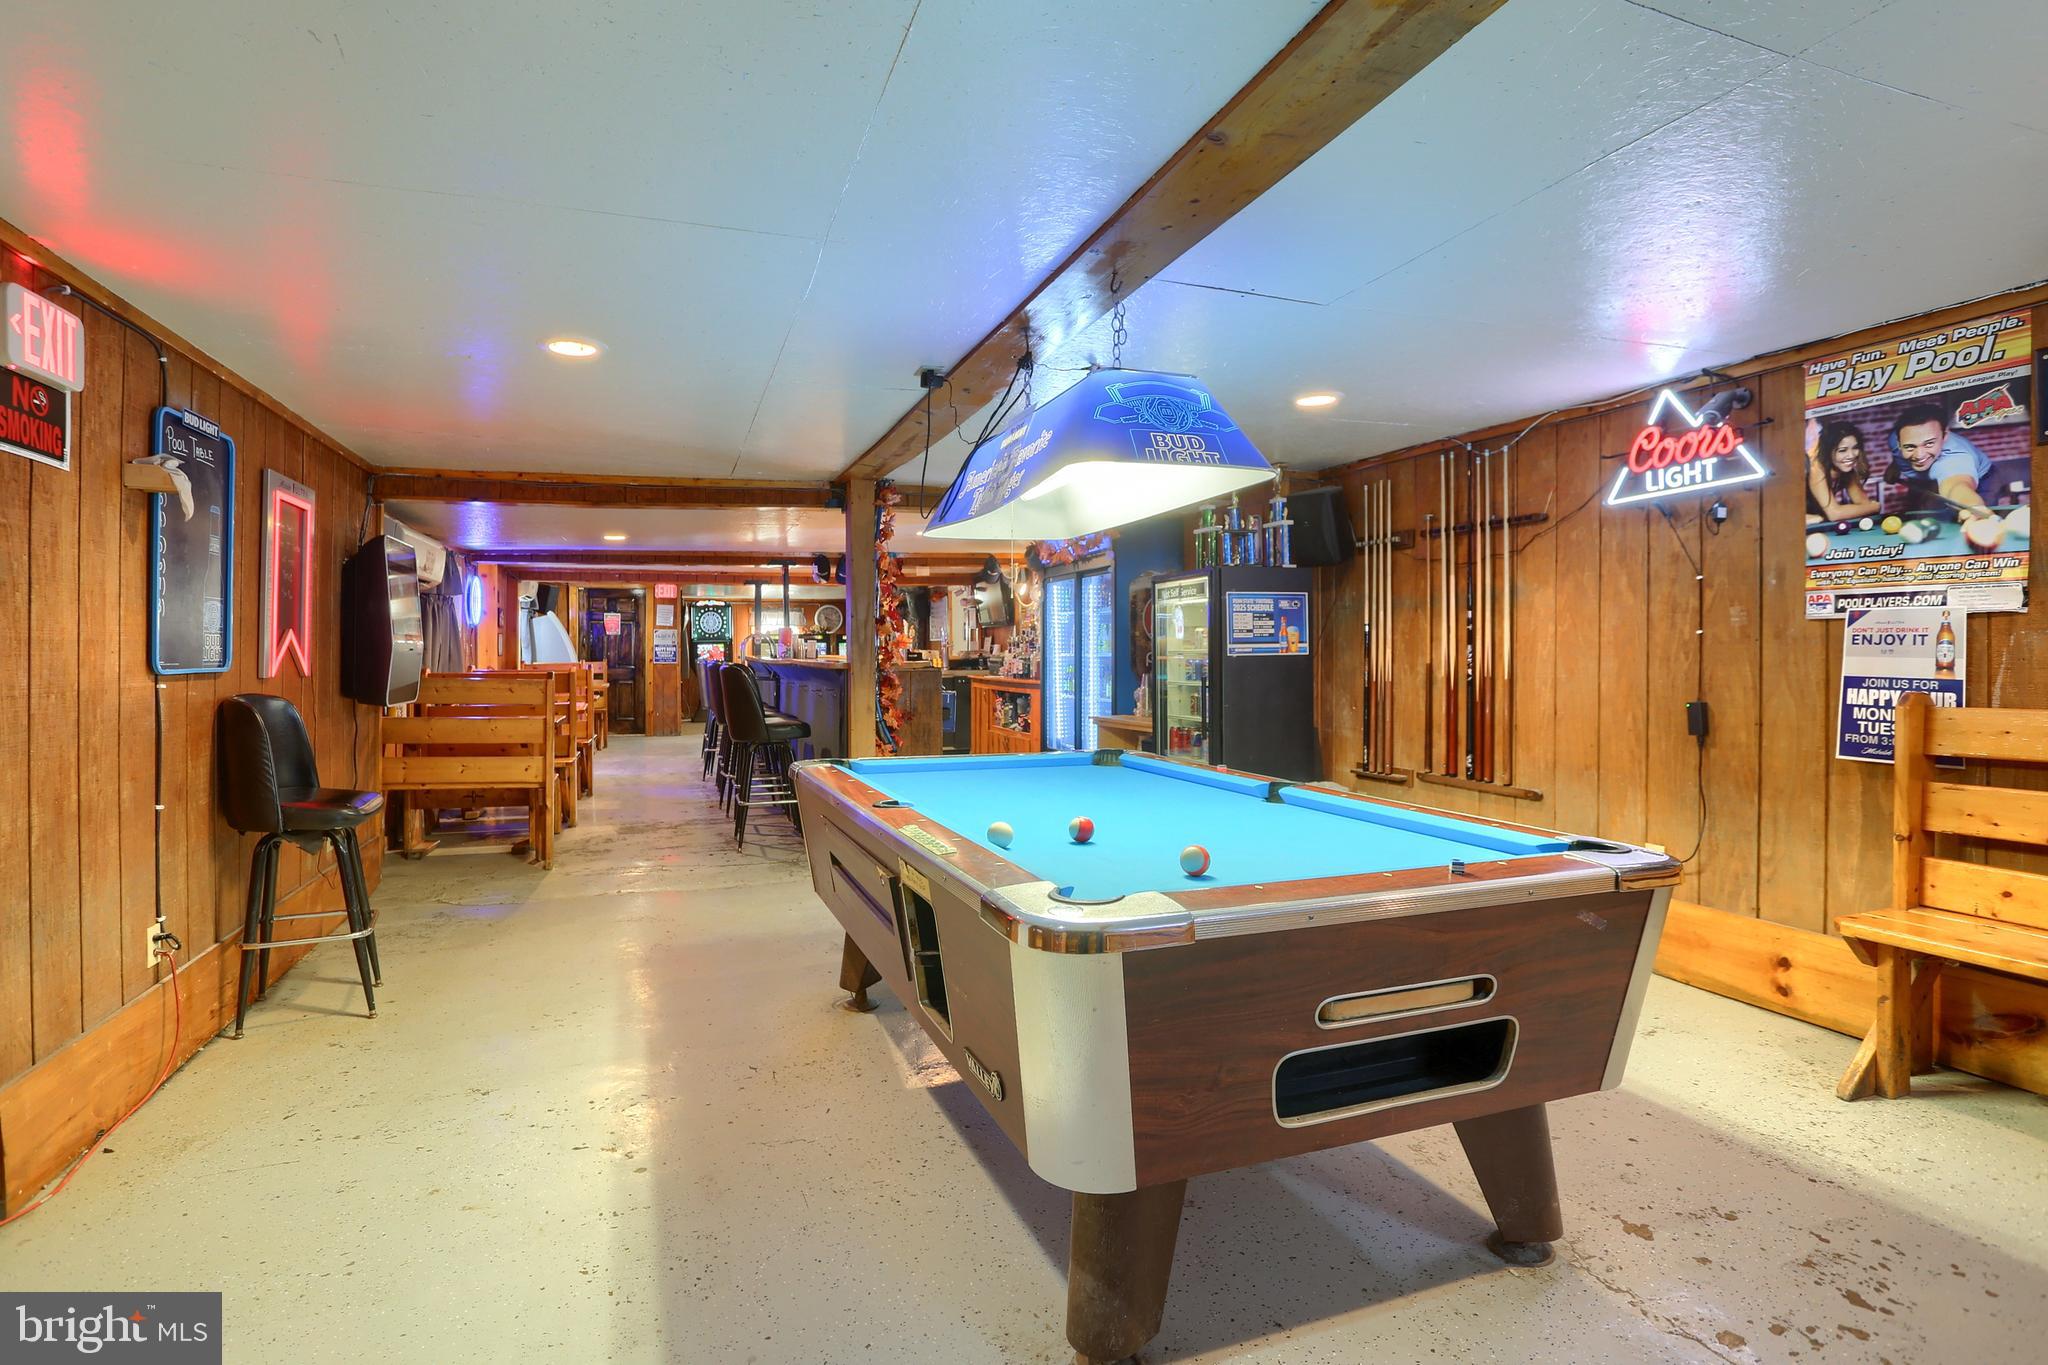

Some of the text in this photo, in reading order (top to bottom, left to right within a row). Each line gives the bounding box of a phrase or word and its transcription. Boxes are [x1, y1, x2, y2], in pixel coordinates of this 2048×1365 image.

[23, 291, 78, 383] EXIT
[1808, 316, 2024, 375] Have Fun. Meet People.
[1817, 334, 2006, 398] Play Pool.
[1923, 385, 1939, 393] APA
[1940, 380, 1966, 389] weekly
[1967, 374, 1996, 384] League
[0, 405, 63, 457] SMOKING
[184, 411, 219, 437] BUD LIGHT
[1150, 432, 1206, 452] BUD
[1629, 423, 1744, 474] Coors
[1145, 448, 1220, 464] LIGHT
[1645, 458, 1718, 492] LIGHT
[1826, 544, 1904, 560] Join Today!
[1810, 557, 2020, 579] Everyone Can Play... Anyone Can Win
[1935, 571, 1965, 580] scoring
[1967, 569, 2002, 578] system!
[1808, 594, 1832, 603] APA
[1838, 595, 1944, 609] POOLPLAYERS.COM
[205, 634, 221, 647] BUD
[1852, 634, 1929, 646] ENJOY IT
[1862, 678, 1939, 690] JOIN US FOR
[1846, 688, 1901, 707] HAPPY
[1845, 733, 1878, 745] FROM
